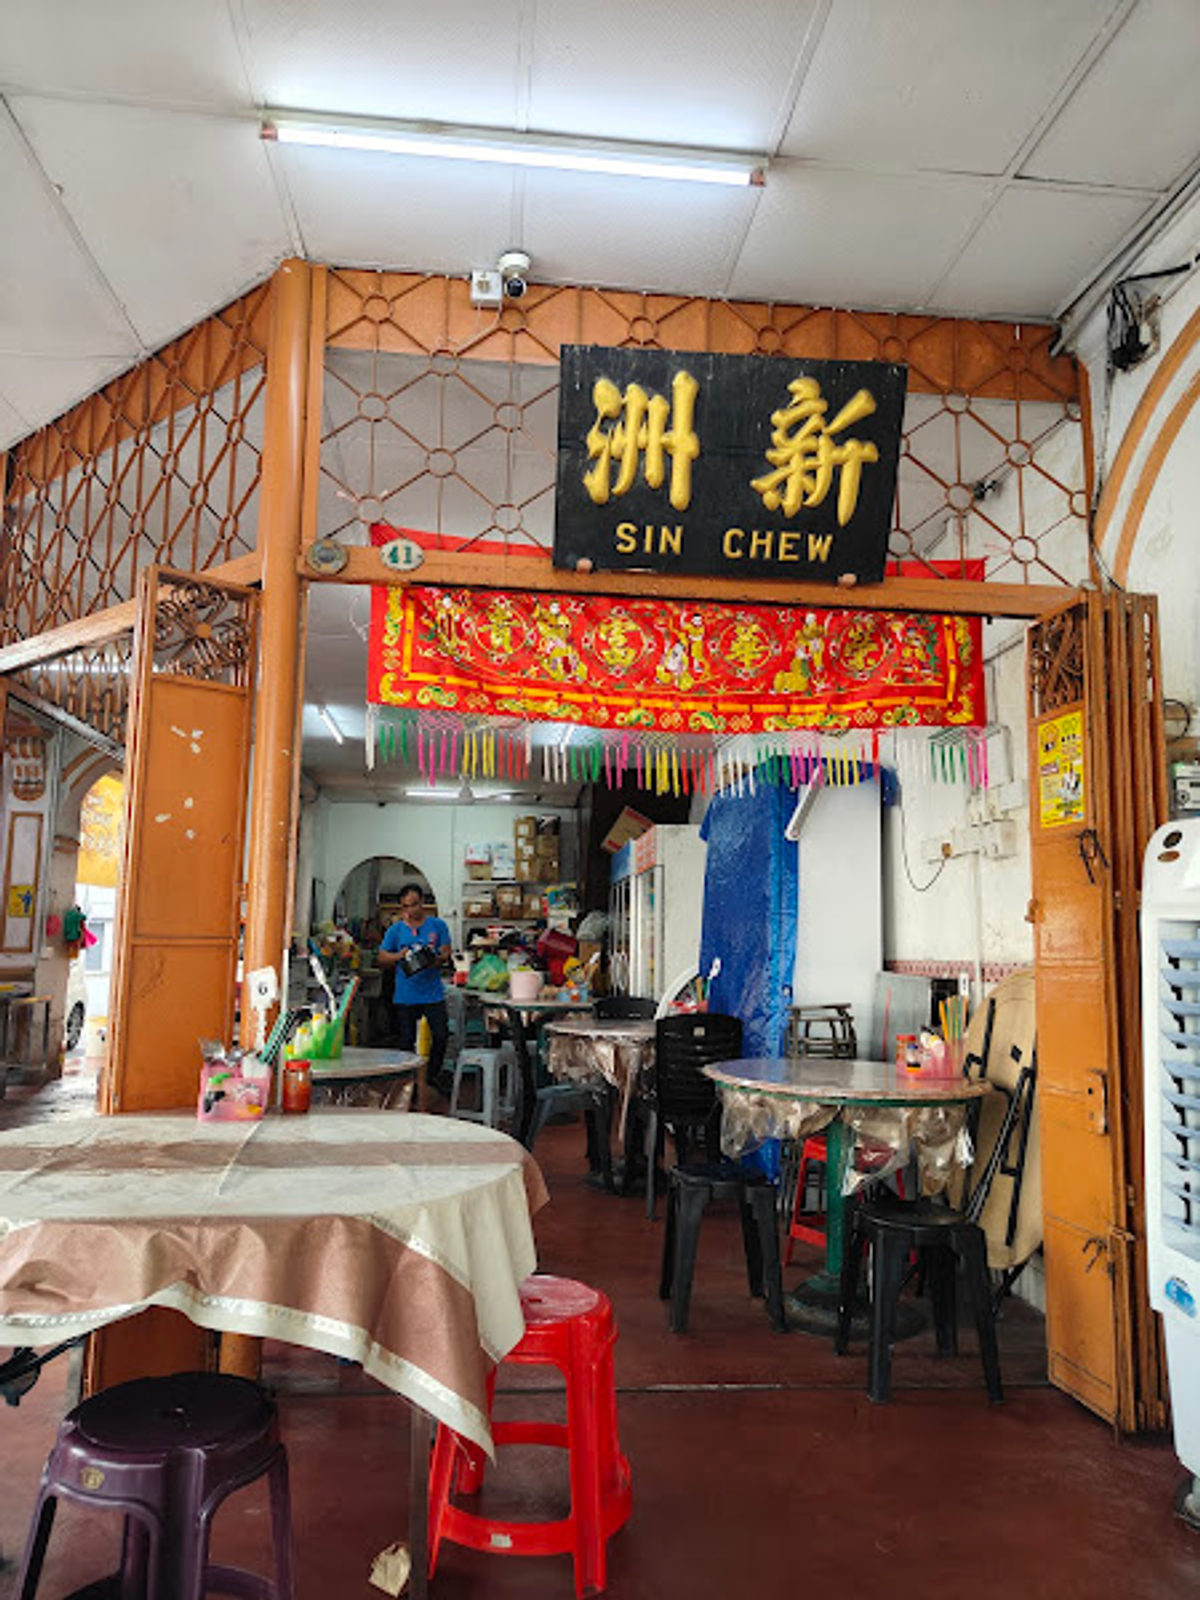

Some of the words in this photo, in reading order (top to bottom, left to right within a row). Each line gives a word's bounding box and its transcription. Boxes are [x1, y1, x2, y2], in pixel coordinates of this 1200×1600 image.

[388, 545, 412, 564] 41
[616, 522, 683, 554] SIN
[723, 528, 833, 562] CHEW
